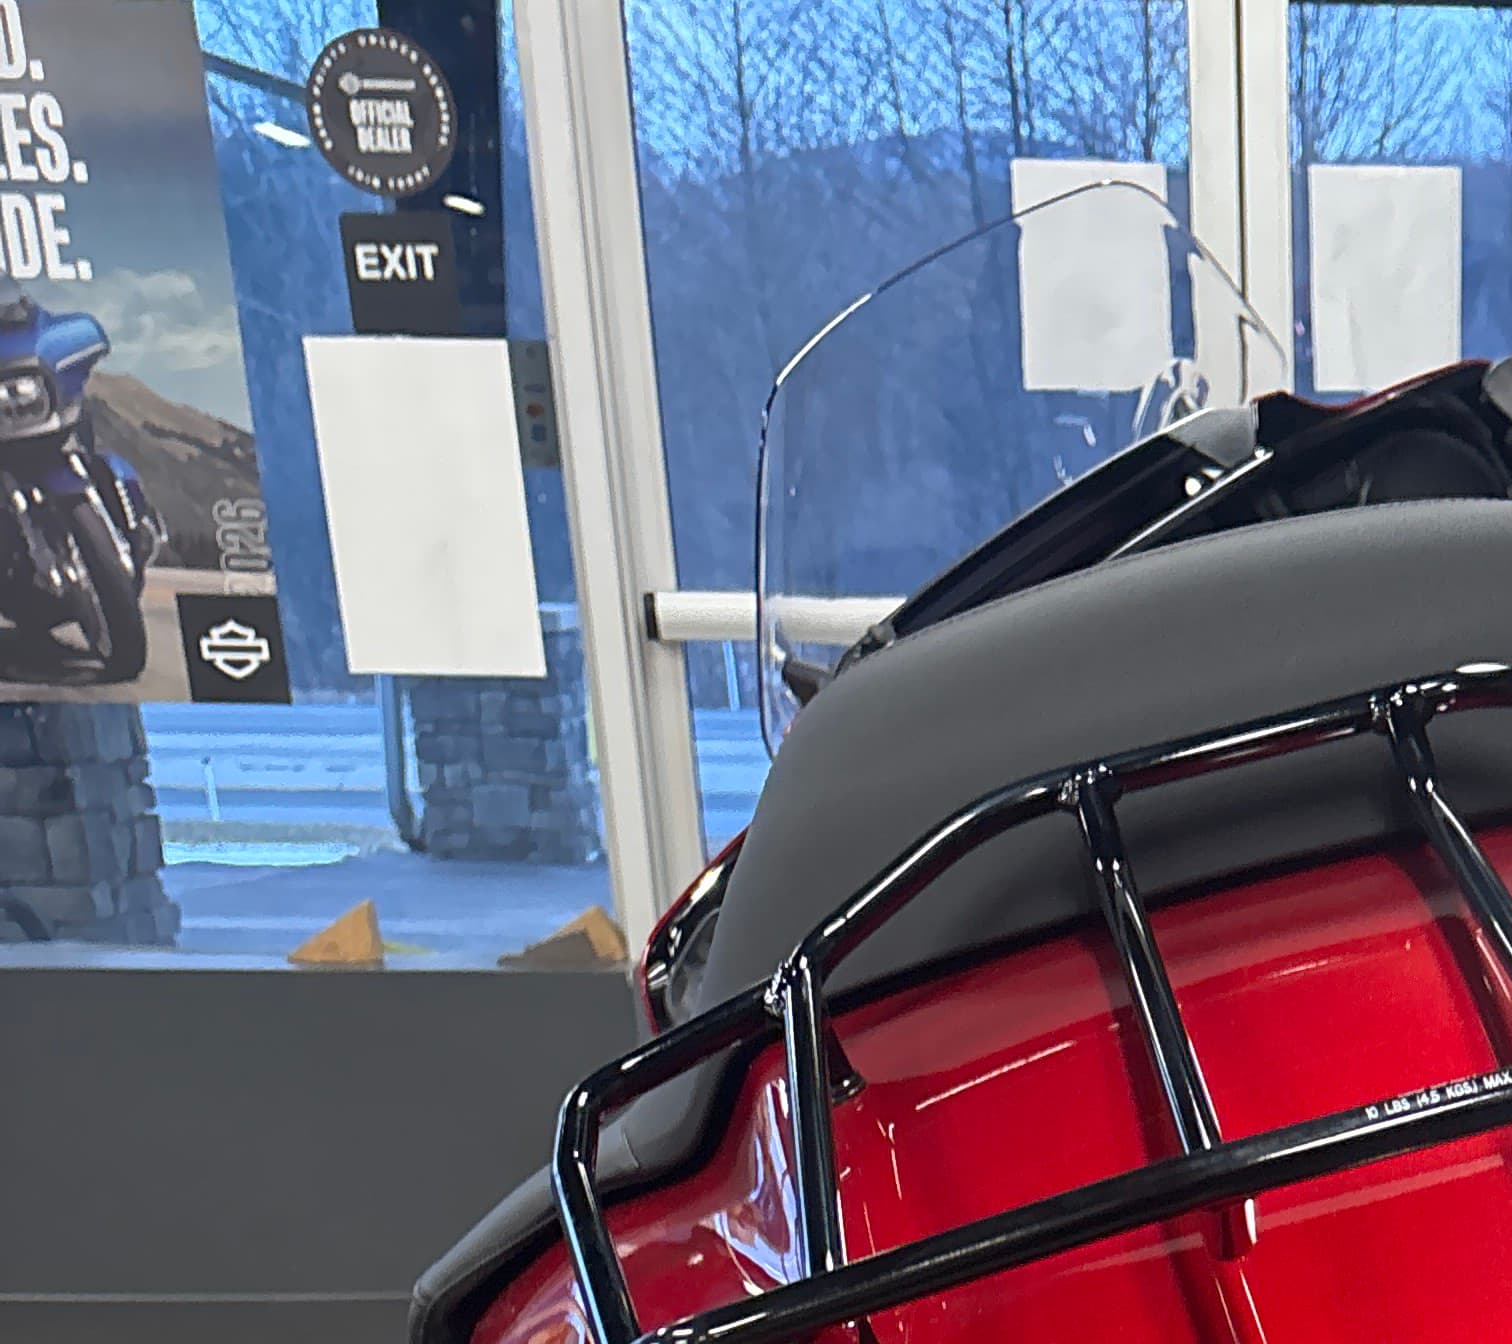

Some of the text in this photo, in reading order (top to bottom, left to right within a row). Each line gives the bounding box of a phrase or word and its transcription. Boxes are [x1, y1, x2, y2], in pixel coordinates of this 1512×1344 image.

[0, 92, 88, 182] ES.
[0, 192, 93, 280] DE.
[354, 243, 439, 281] EXIT
[1365, 1106, 1379, 1121] 10
